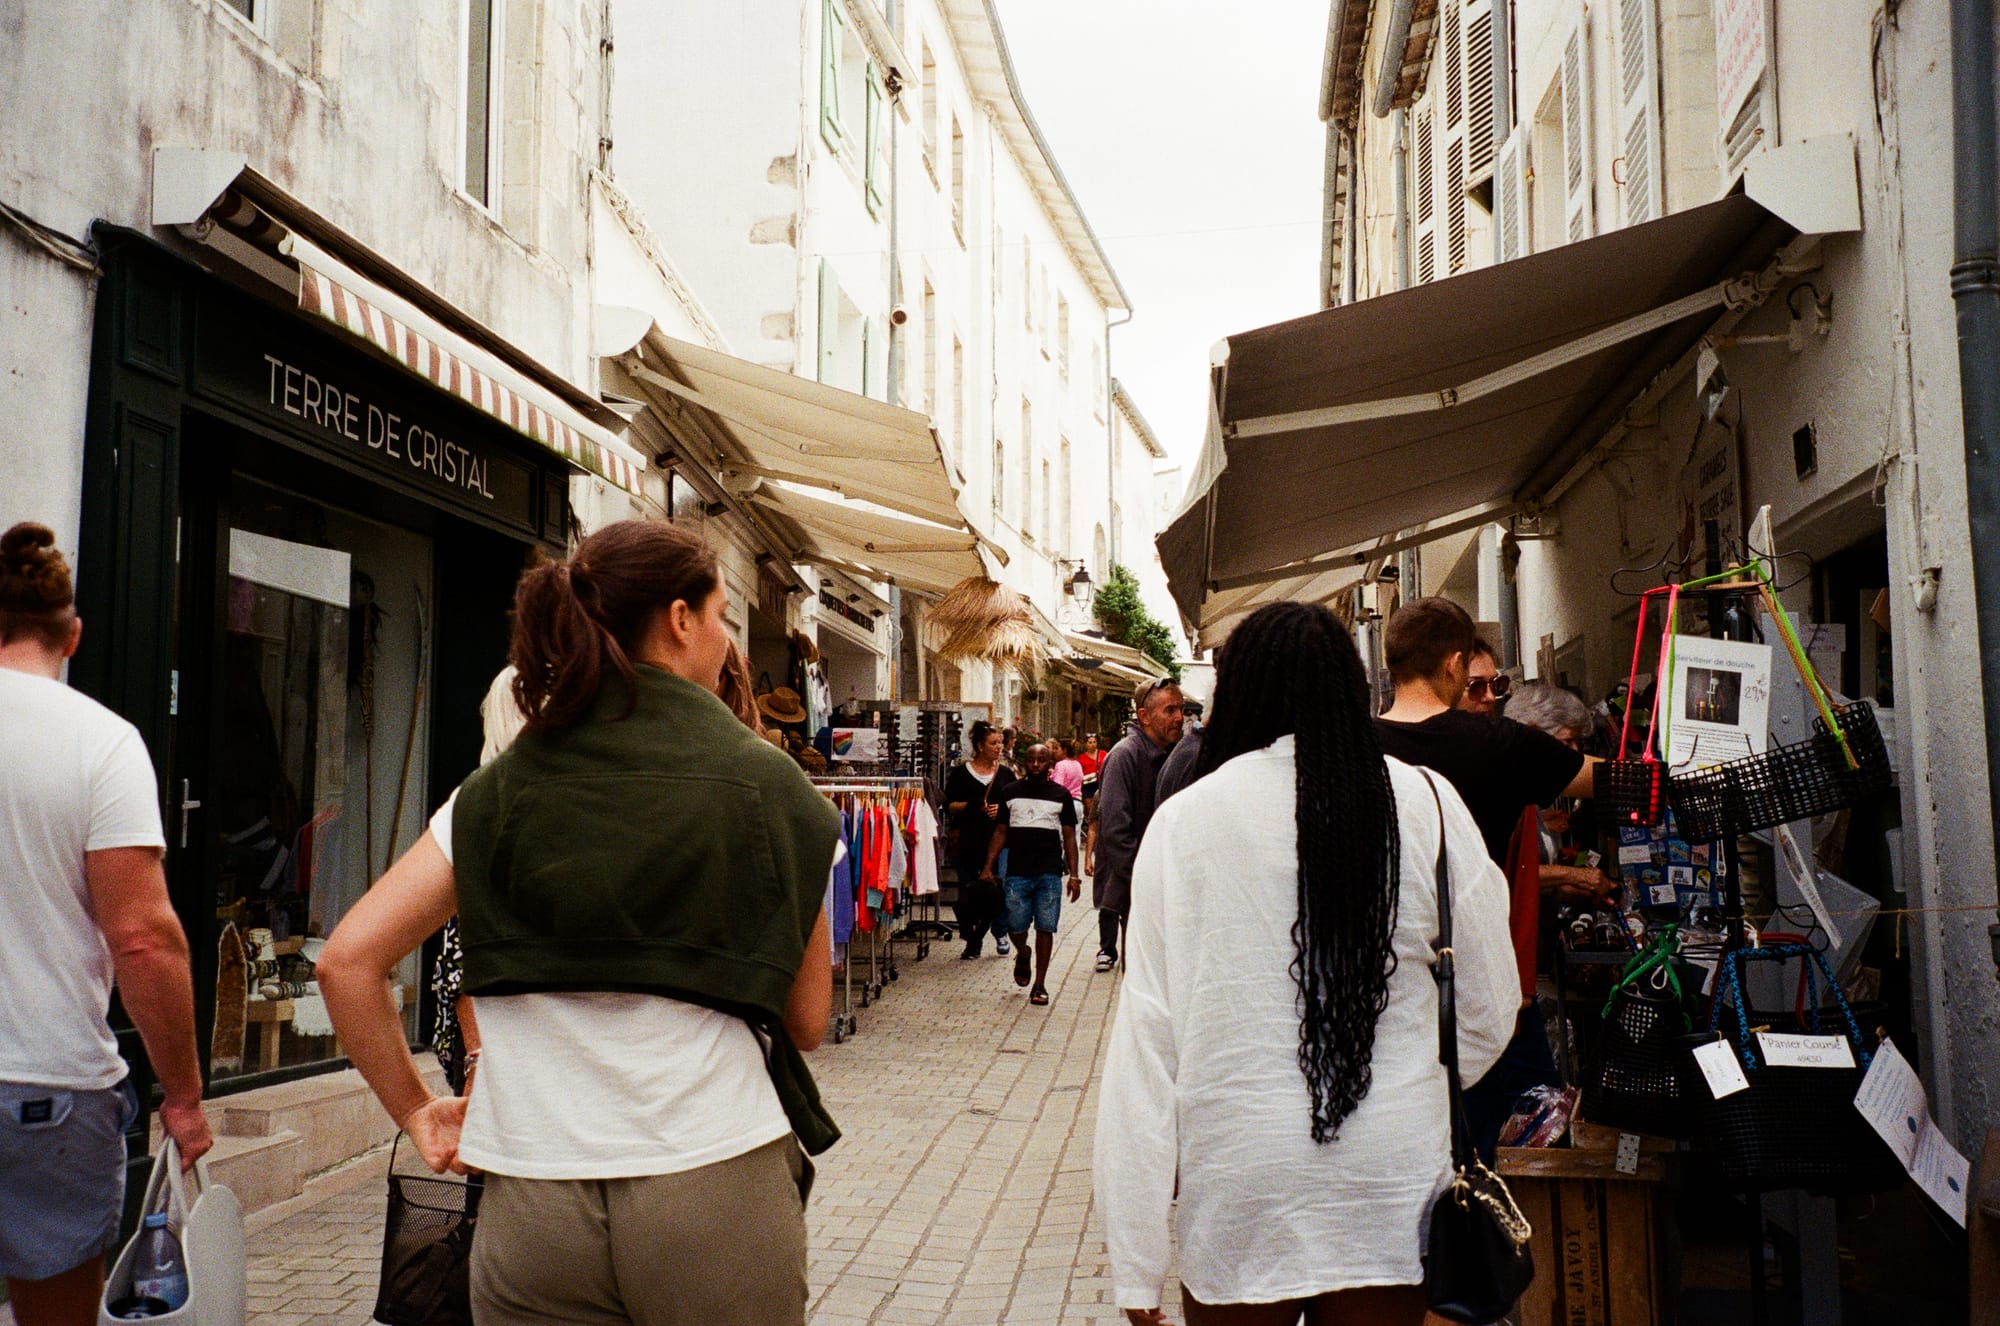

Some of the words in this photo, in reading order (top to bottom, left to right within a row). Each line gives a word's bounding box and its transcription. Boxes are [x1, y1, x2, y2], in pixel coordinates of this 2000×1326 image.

[263, 353, 361, 441] TERRE
[367, 403, 401, 459] DE
[407, 425, 495, 500] CRISTAL
[1767, 1037, 1801, 1049] Panier
[1567, 1229, 1584, 1293] JAVOY
